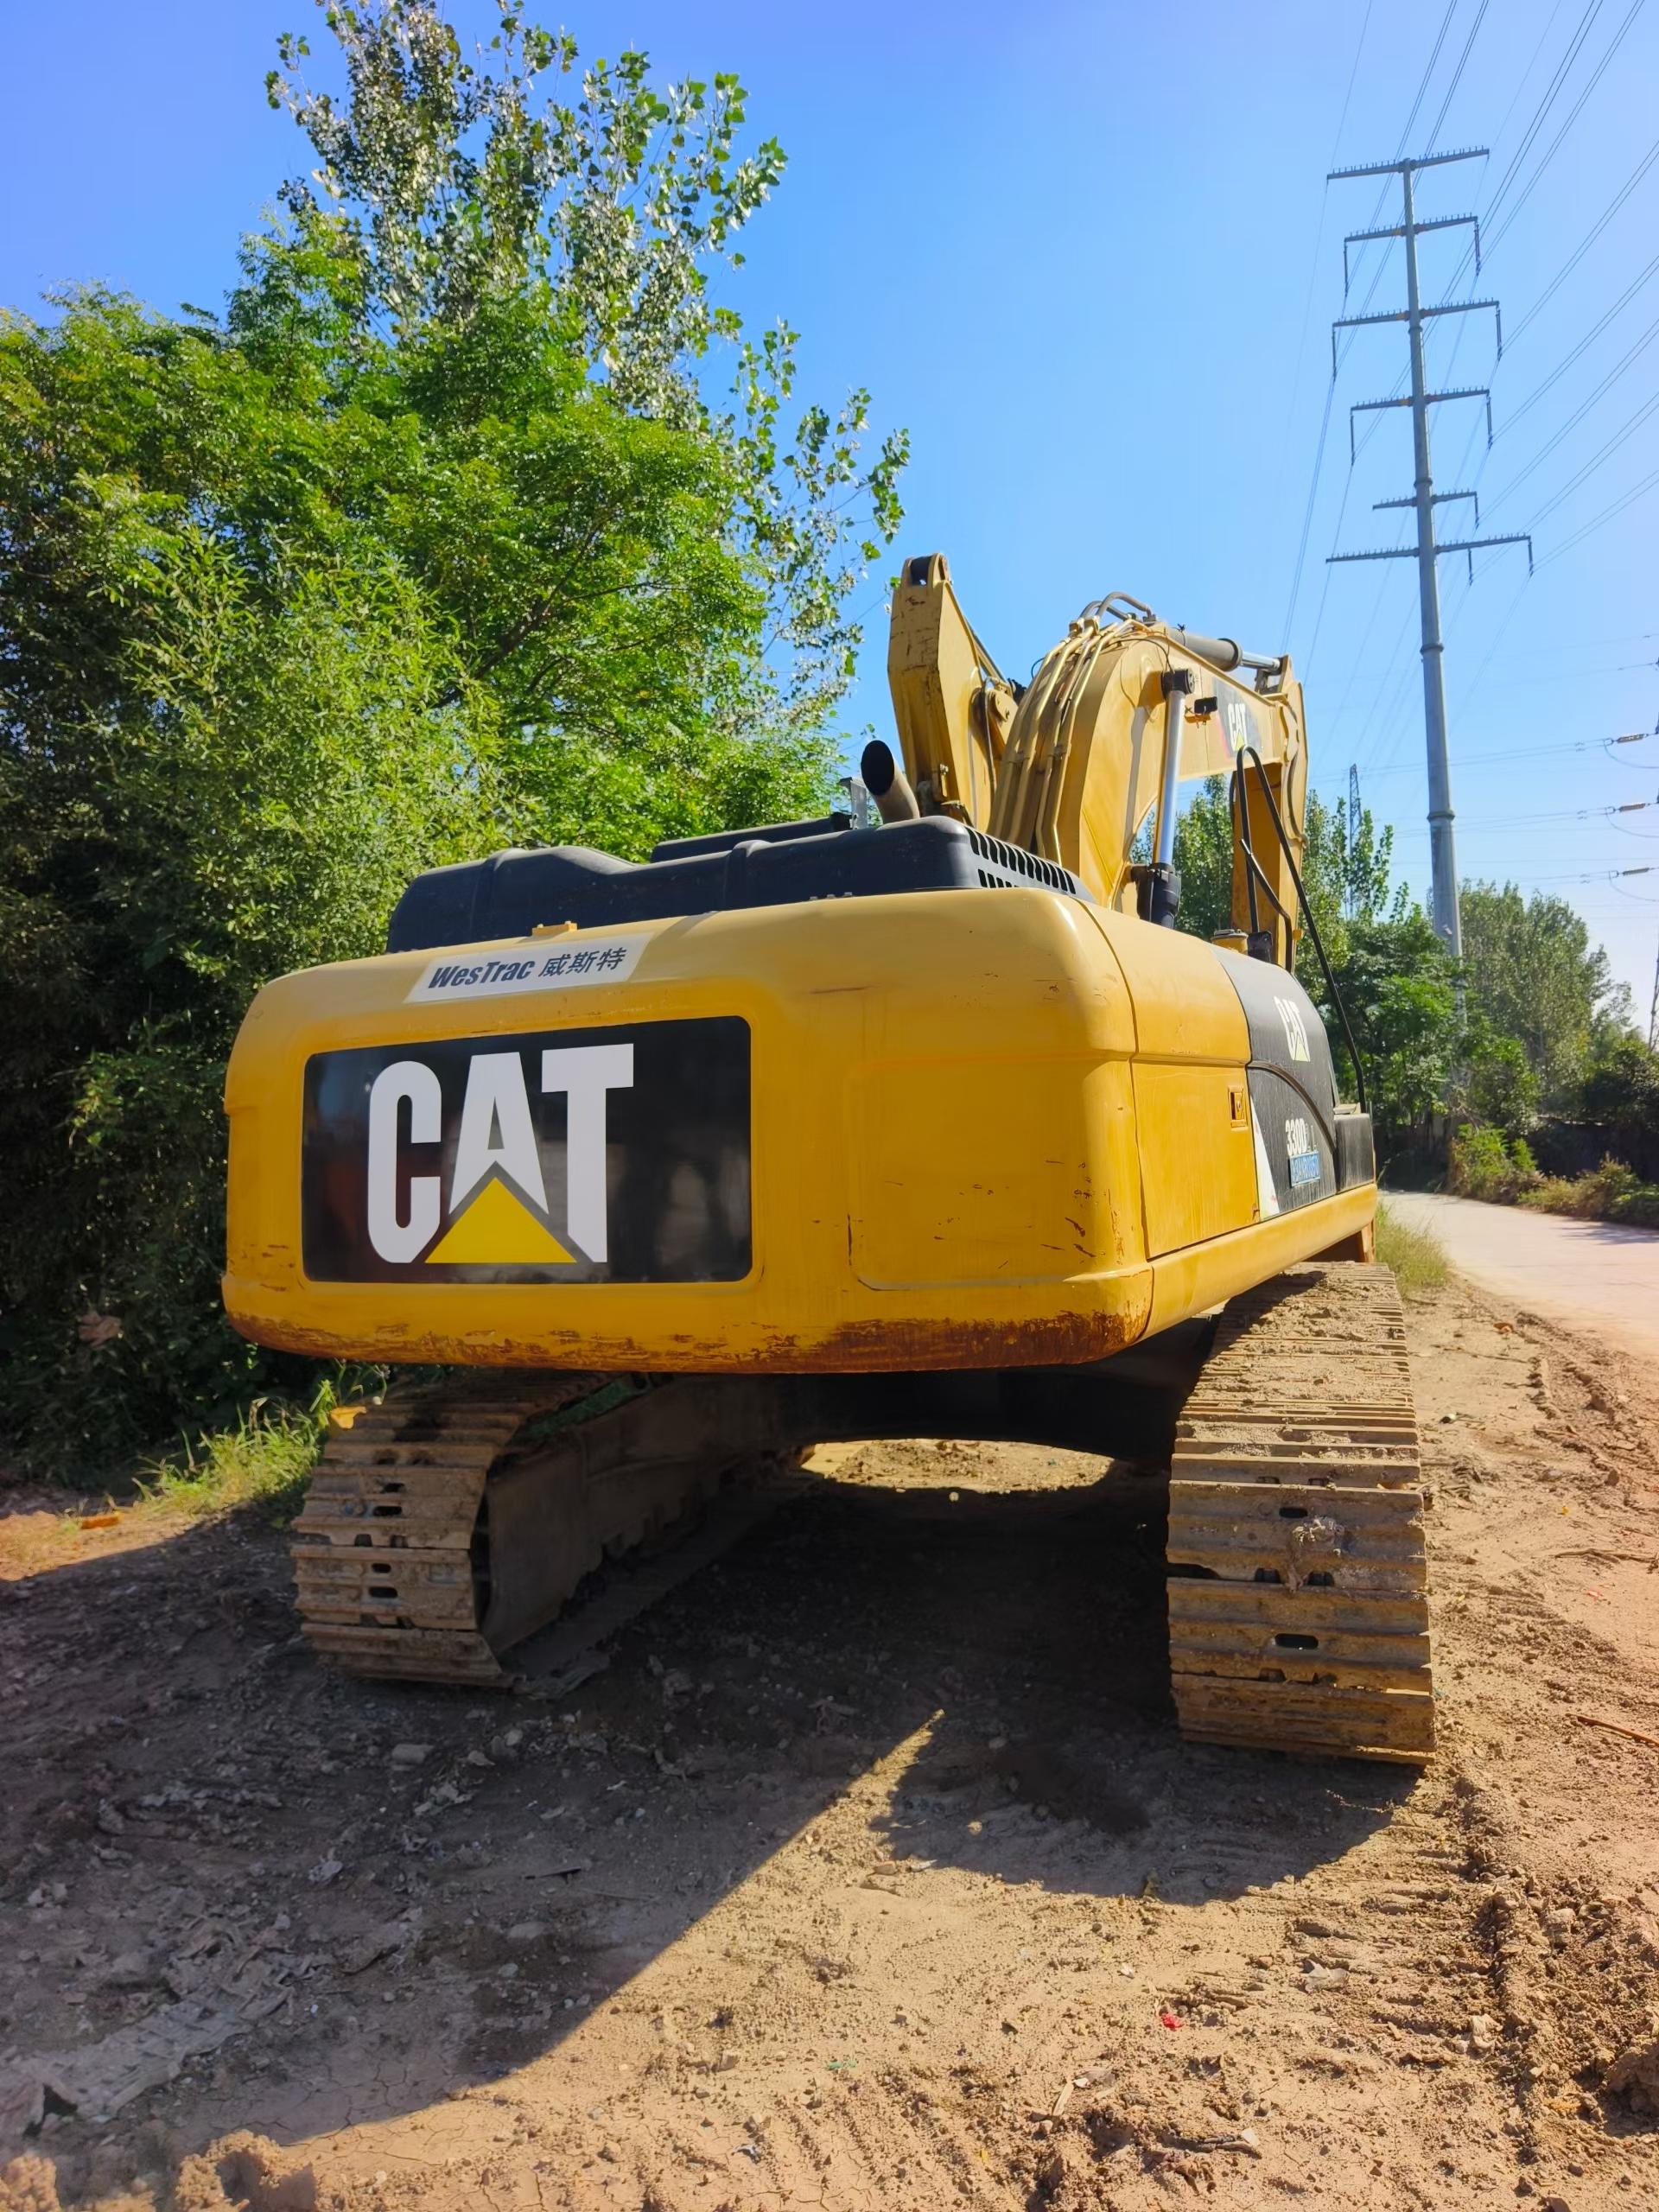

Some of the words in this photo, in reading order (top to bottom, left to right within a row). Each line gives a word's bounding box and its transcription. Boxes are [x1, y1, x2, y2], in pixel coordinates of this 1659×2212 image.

[1228, 702, 1248, 752] CAT
[428, 960, 536, 989] WesTrac
[538, 947, 627, 977] 威斯特
[1274, 995, 1311, 1062] CAT
[367, 1043, 634, 1263] CAT
